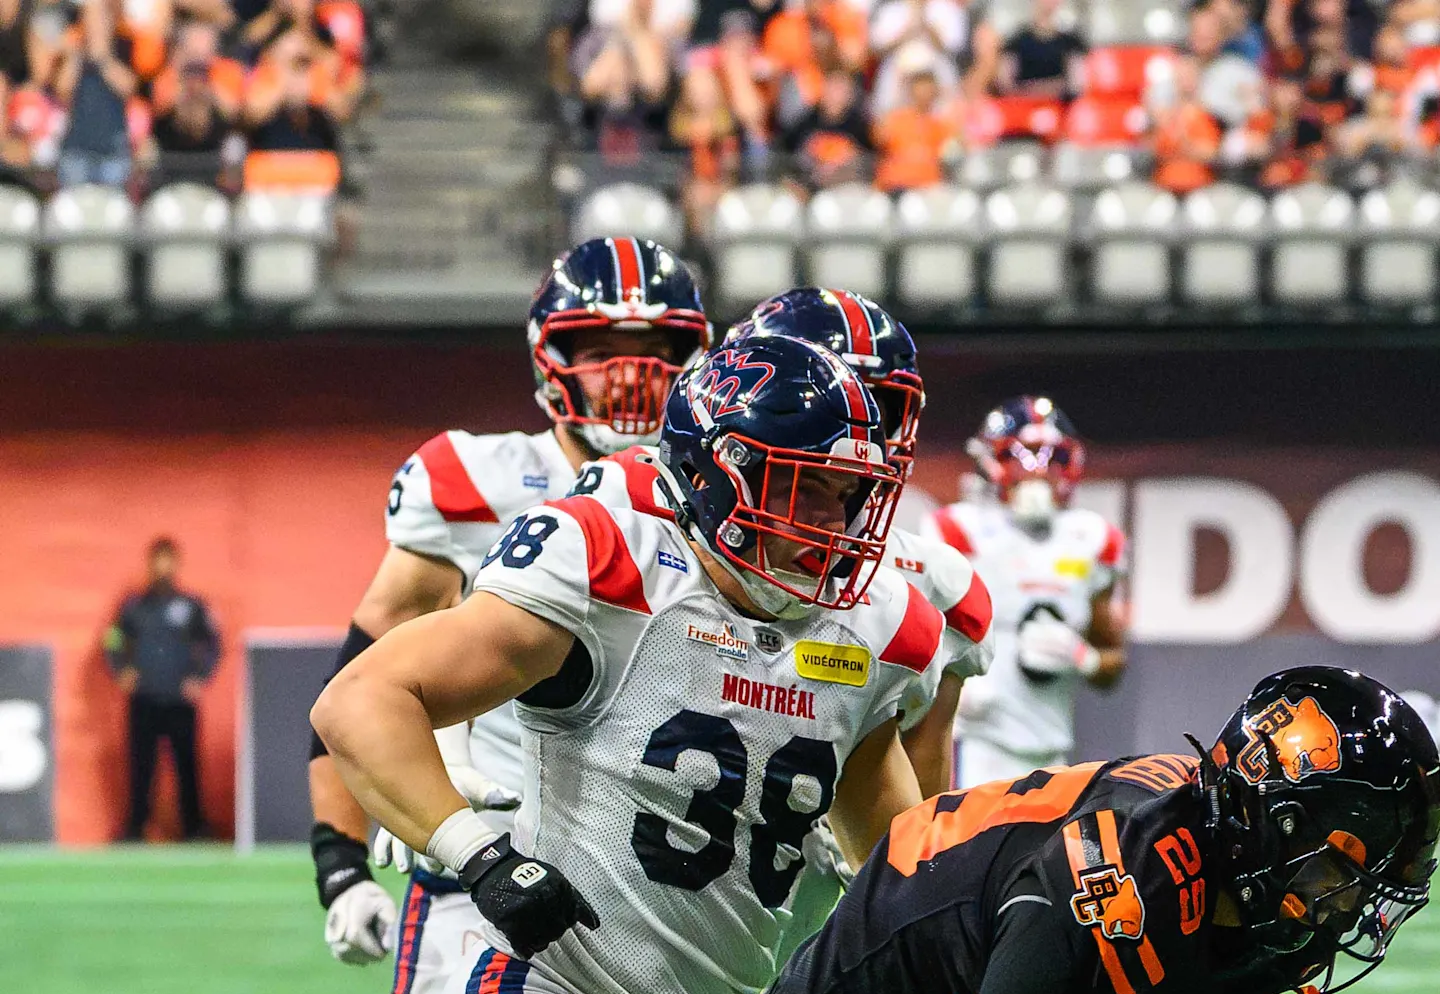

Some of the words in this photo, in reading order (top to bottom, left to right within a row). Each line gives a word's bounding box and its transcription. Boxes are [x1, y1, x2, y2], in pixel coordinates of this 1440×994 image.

[686, 624, 749, 651] Freedom
[718, 647, 747, 659] mobile
[801, 653, 865, 673] VIDÉOTRON
[721, 673, 817, 720] MONTRÉAL
[631, 709, 837, 909] 38
